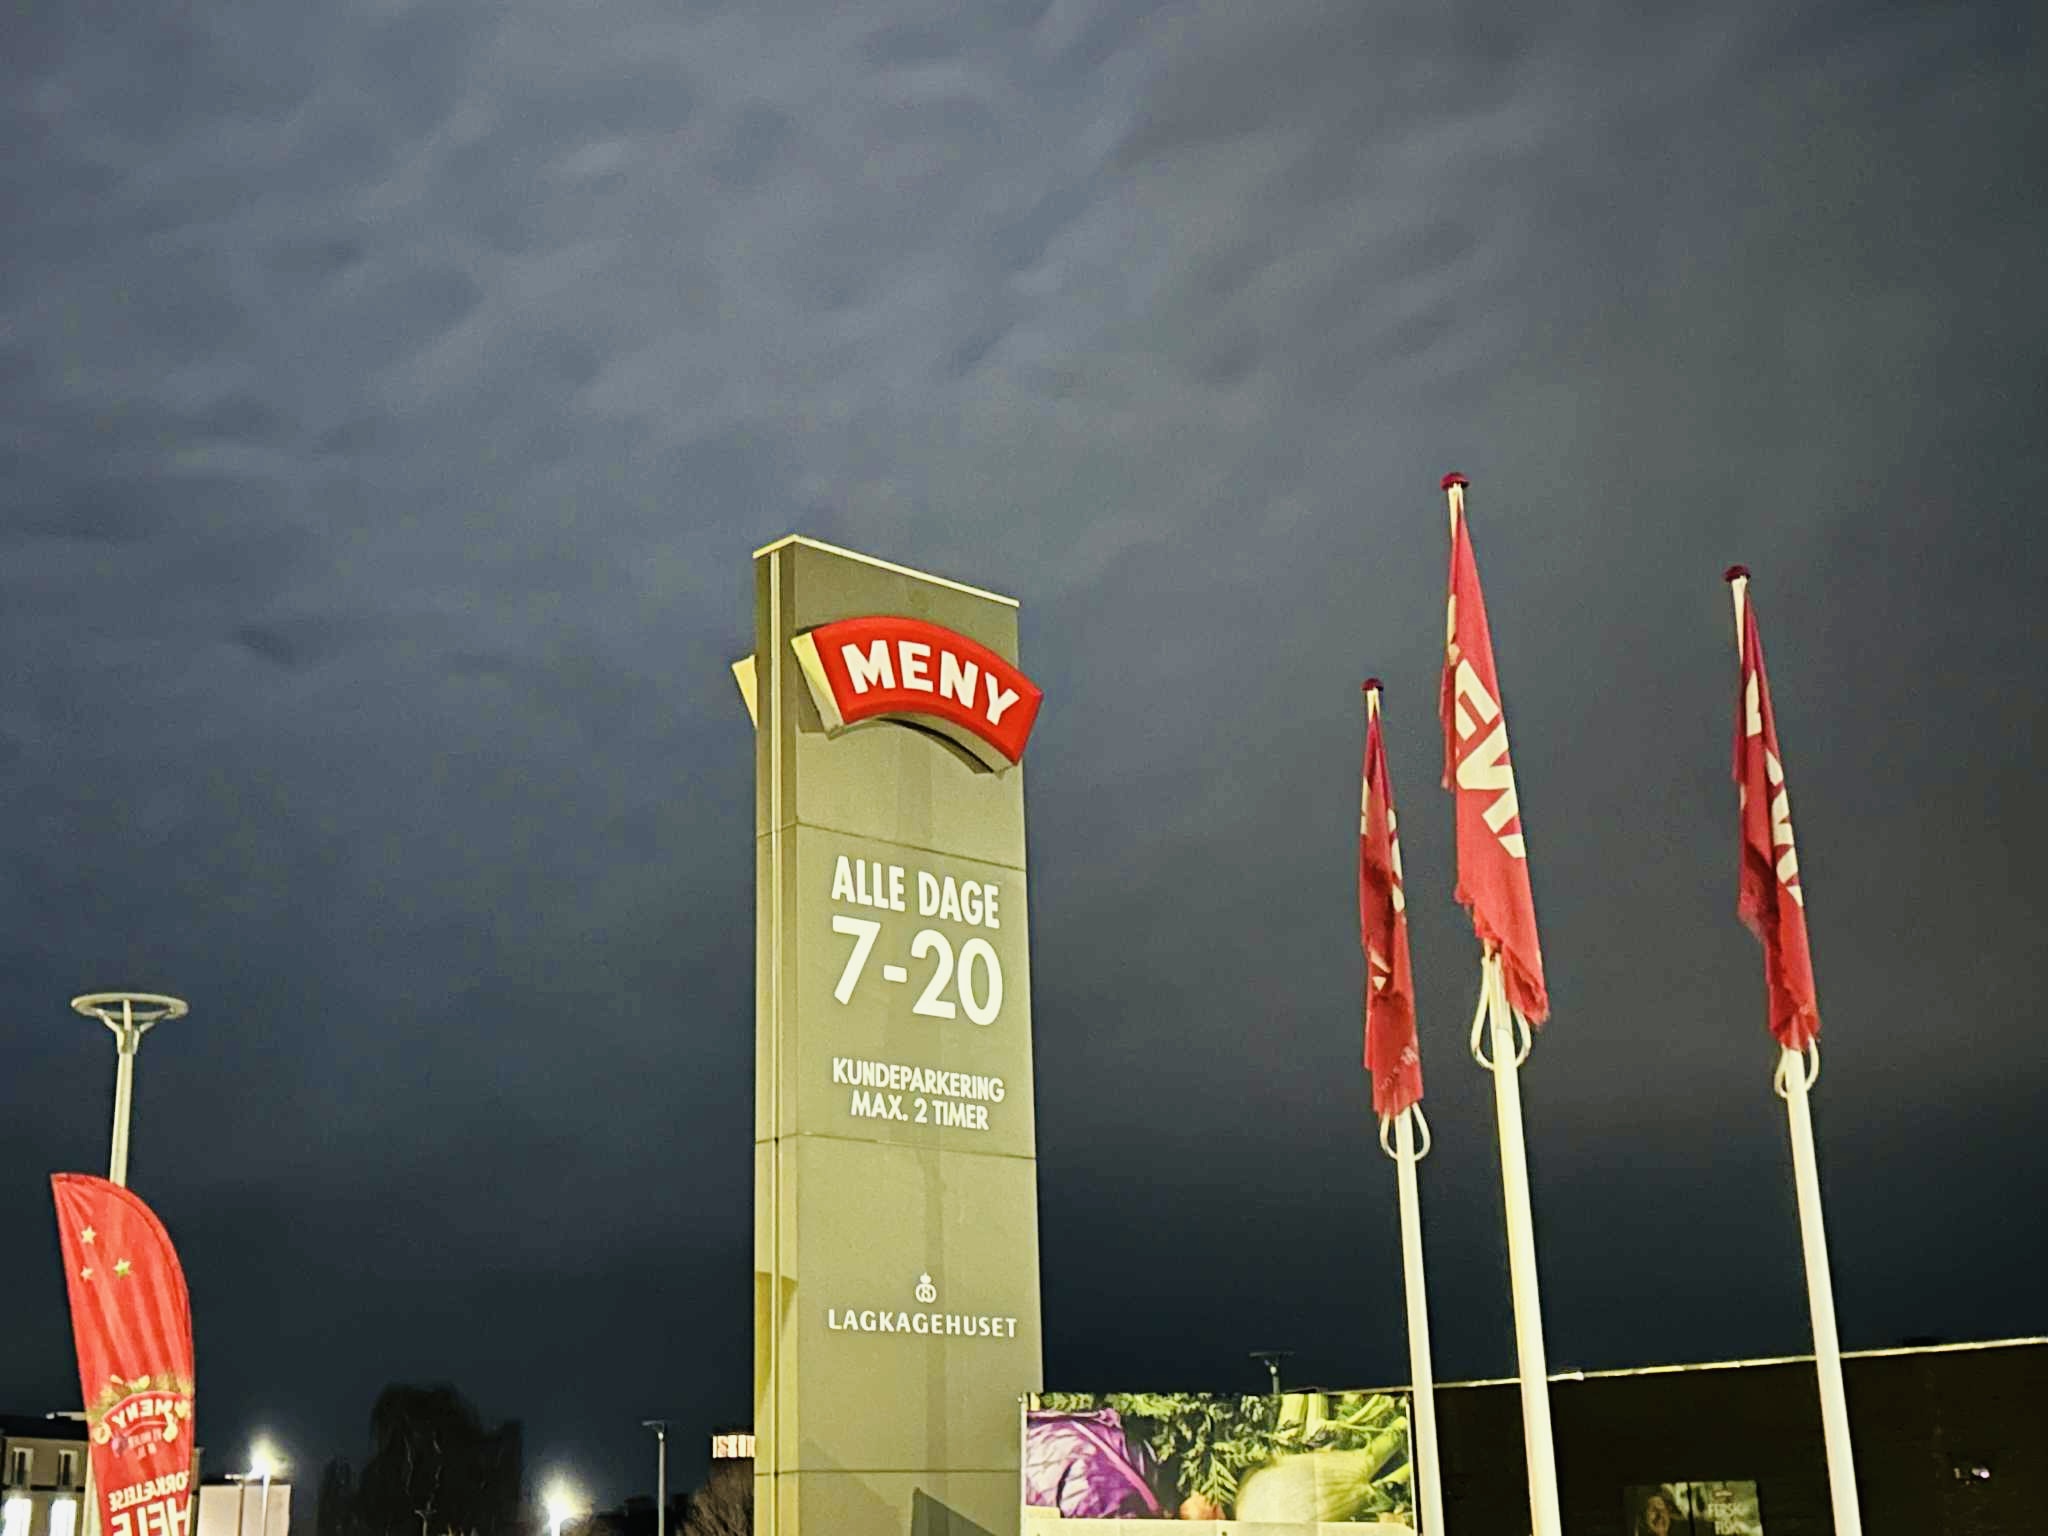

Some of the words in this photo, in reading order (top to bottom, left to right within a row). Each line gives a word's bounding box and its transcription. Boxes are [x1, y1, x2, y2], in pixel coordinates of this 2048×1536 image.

[841, 639, 1020, 726] MENY
[831, 855, 905, 912] ALLE
[918, 871, 1000, 929] DAGE
[832, 1057, 1005, 1102] KUNDEPARKERING
[851, 1090, 908, 1121] MAX.
[914, 1098, 928, 1124] 2
[932, 1100, 990, 1130] TIMER
[828, 1308, 1017, 1337] LAGKAGEHUSET
